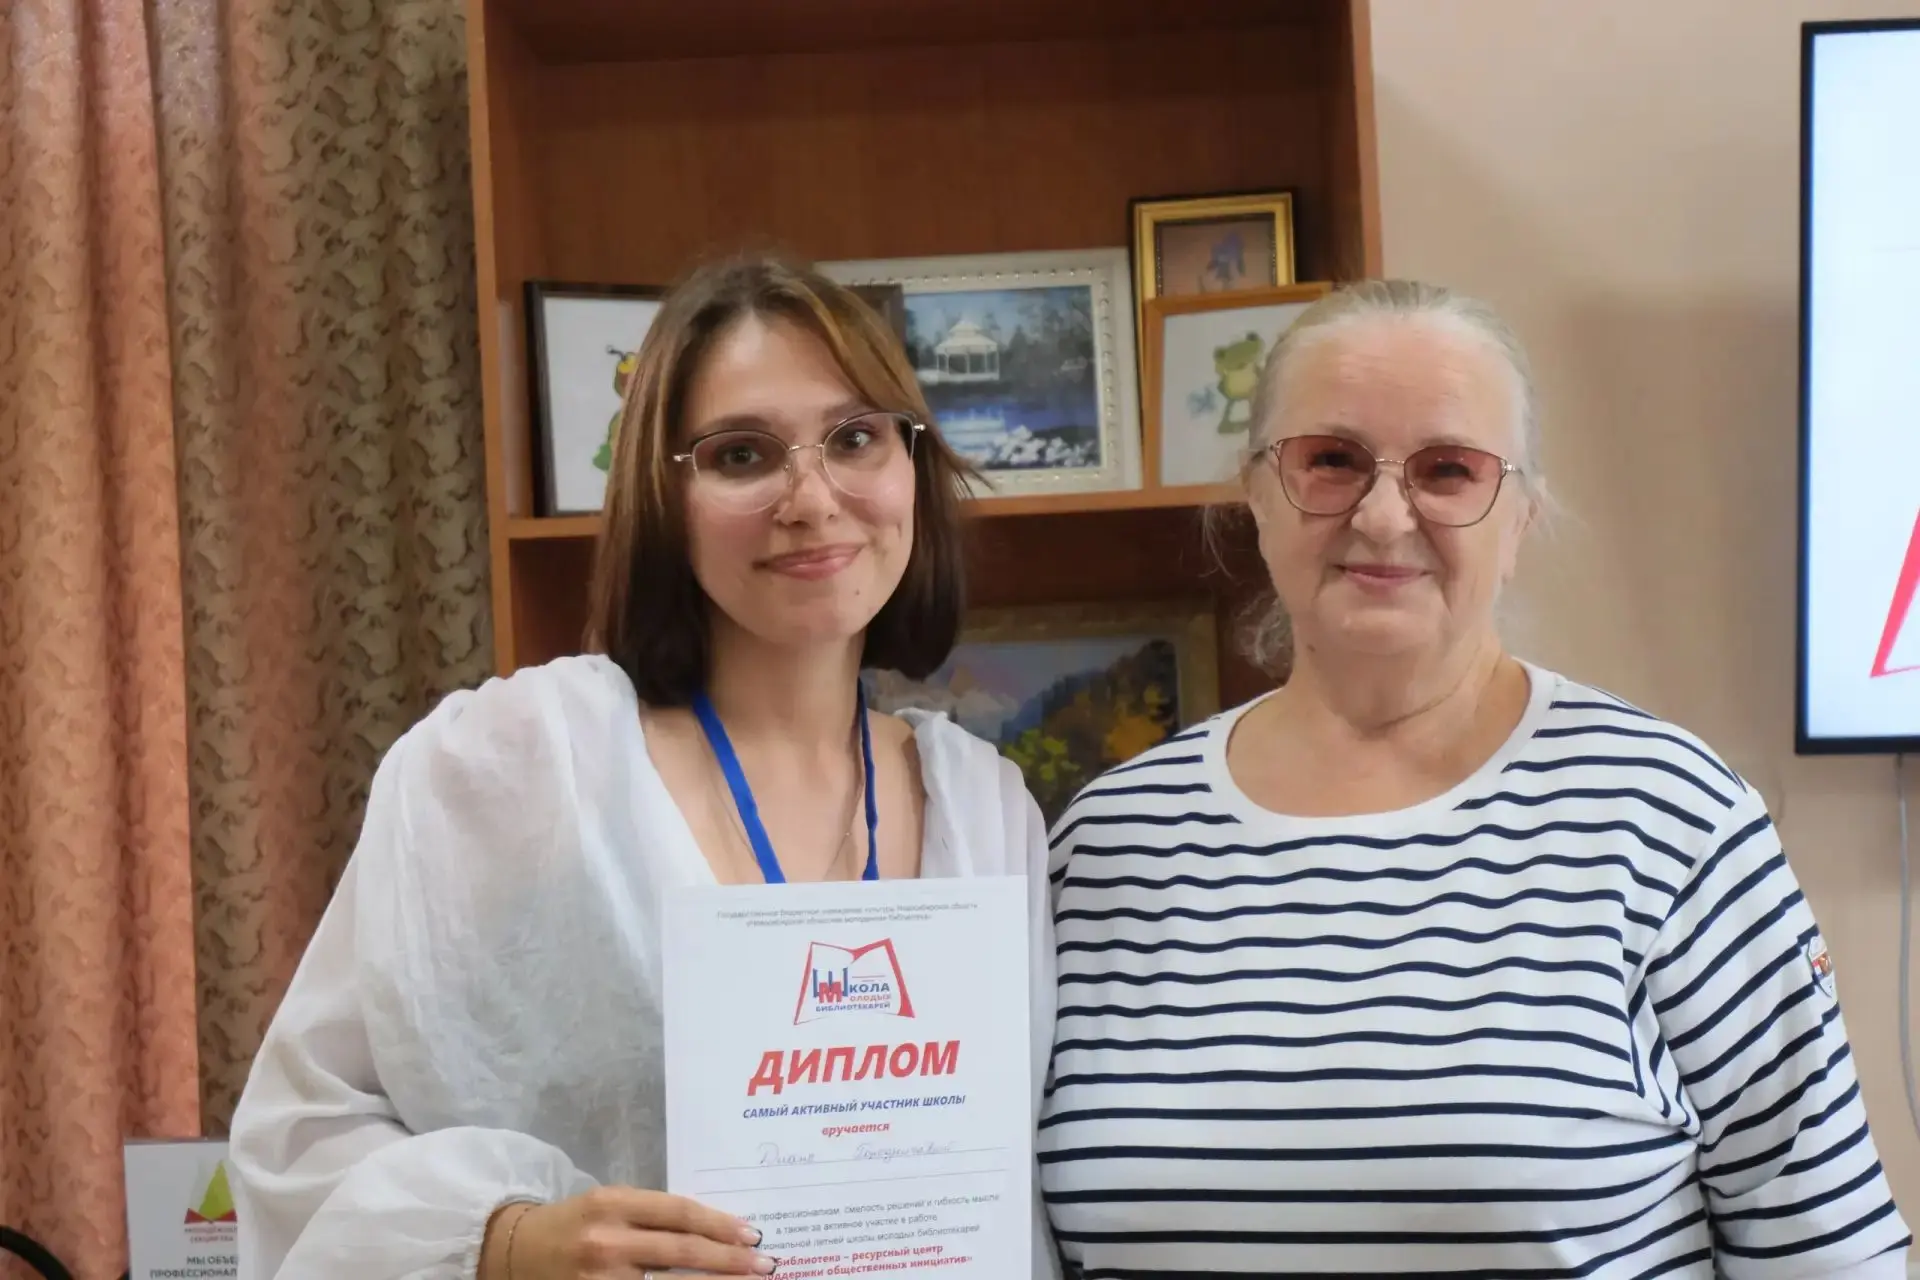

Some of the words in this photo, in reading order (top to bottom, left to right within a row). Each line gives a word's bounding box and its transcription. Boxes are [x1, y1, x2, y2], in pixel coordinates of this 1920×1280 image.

[815, 1001, 892, 1013] БИБЛИОТЕКАРЕЙ
[747, 1040, 960, 1096] ДИПЛОМ
[743, 1106, 788, 1119] САМЫЙ
[791, 1099, 857, 1116] АКТИВНЫЙ
[860, 1097, 919, 1111] УЧАСТНИК
[922, 1094, 966, 1106] ШКОЛЫ
[821, 1121, 891, 1137] вручается
[207, 1254, 239, 1265] ОБЪЕ
[851, 1246, 910, 1262] ресурсный
[912, 1245, 944, 1256] центр
[826, 1261, 908, 1275] общественных
